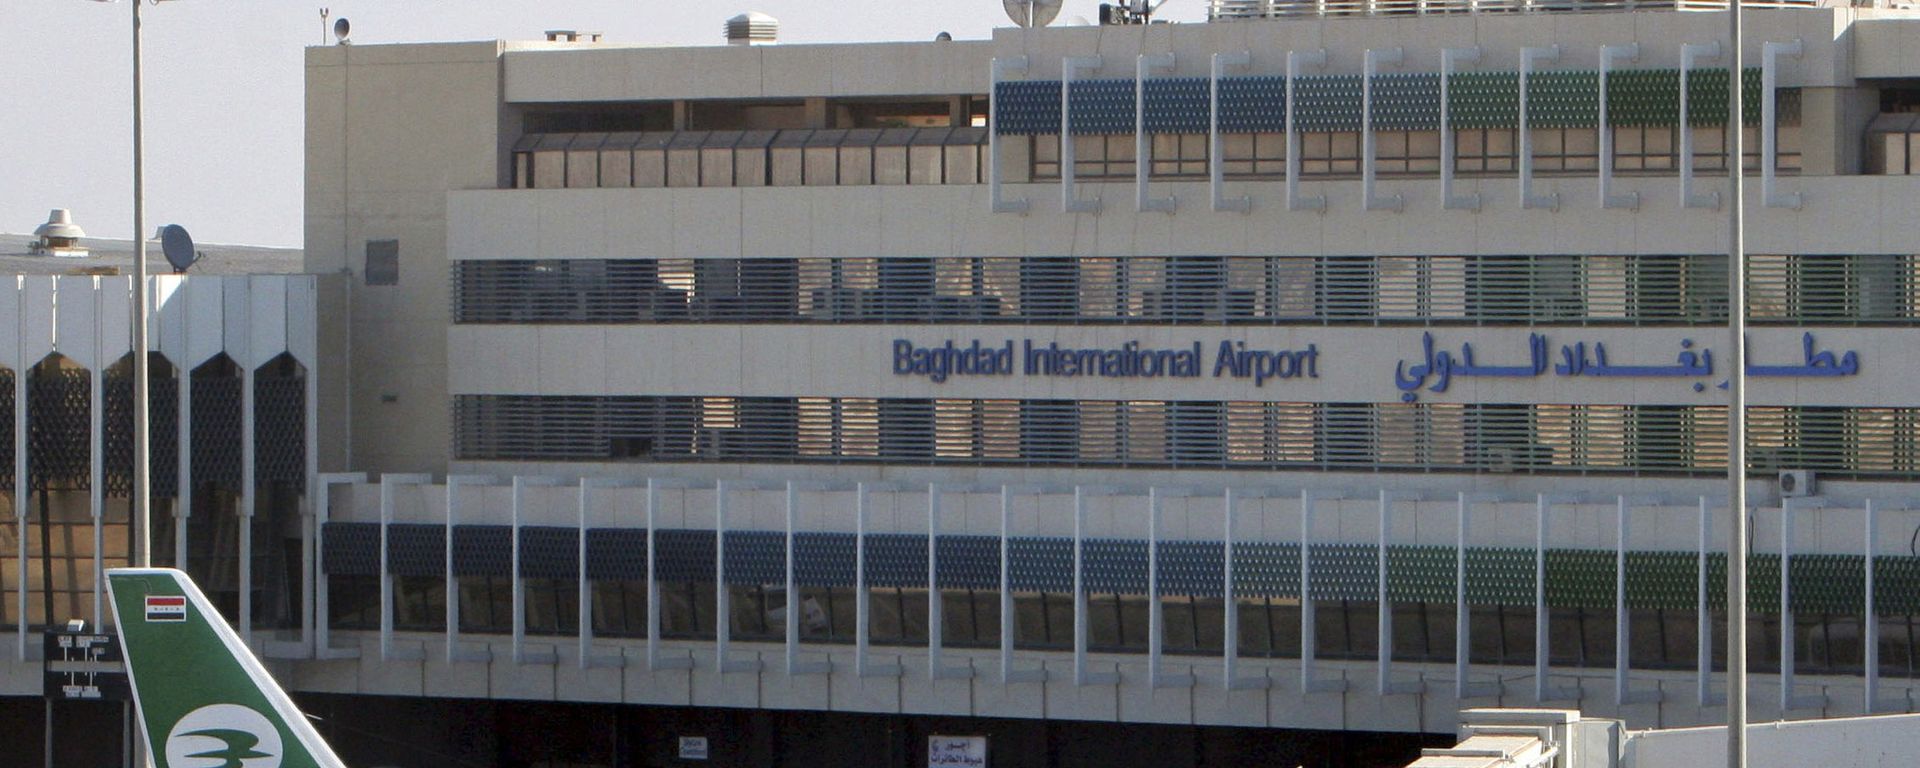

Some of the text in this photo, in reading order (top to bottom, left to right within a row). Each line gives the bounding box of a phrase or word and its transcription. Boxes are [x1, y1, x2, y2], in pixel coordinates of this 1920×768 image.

[892, 338, 1319, 386] Baghdad International Airport
[1394, 330, 1550, 404] الدولي
[1554, 337, 1714, 393] بغداد
